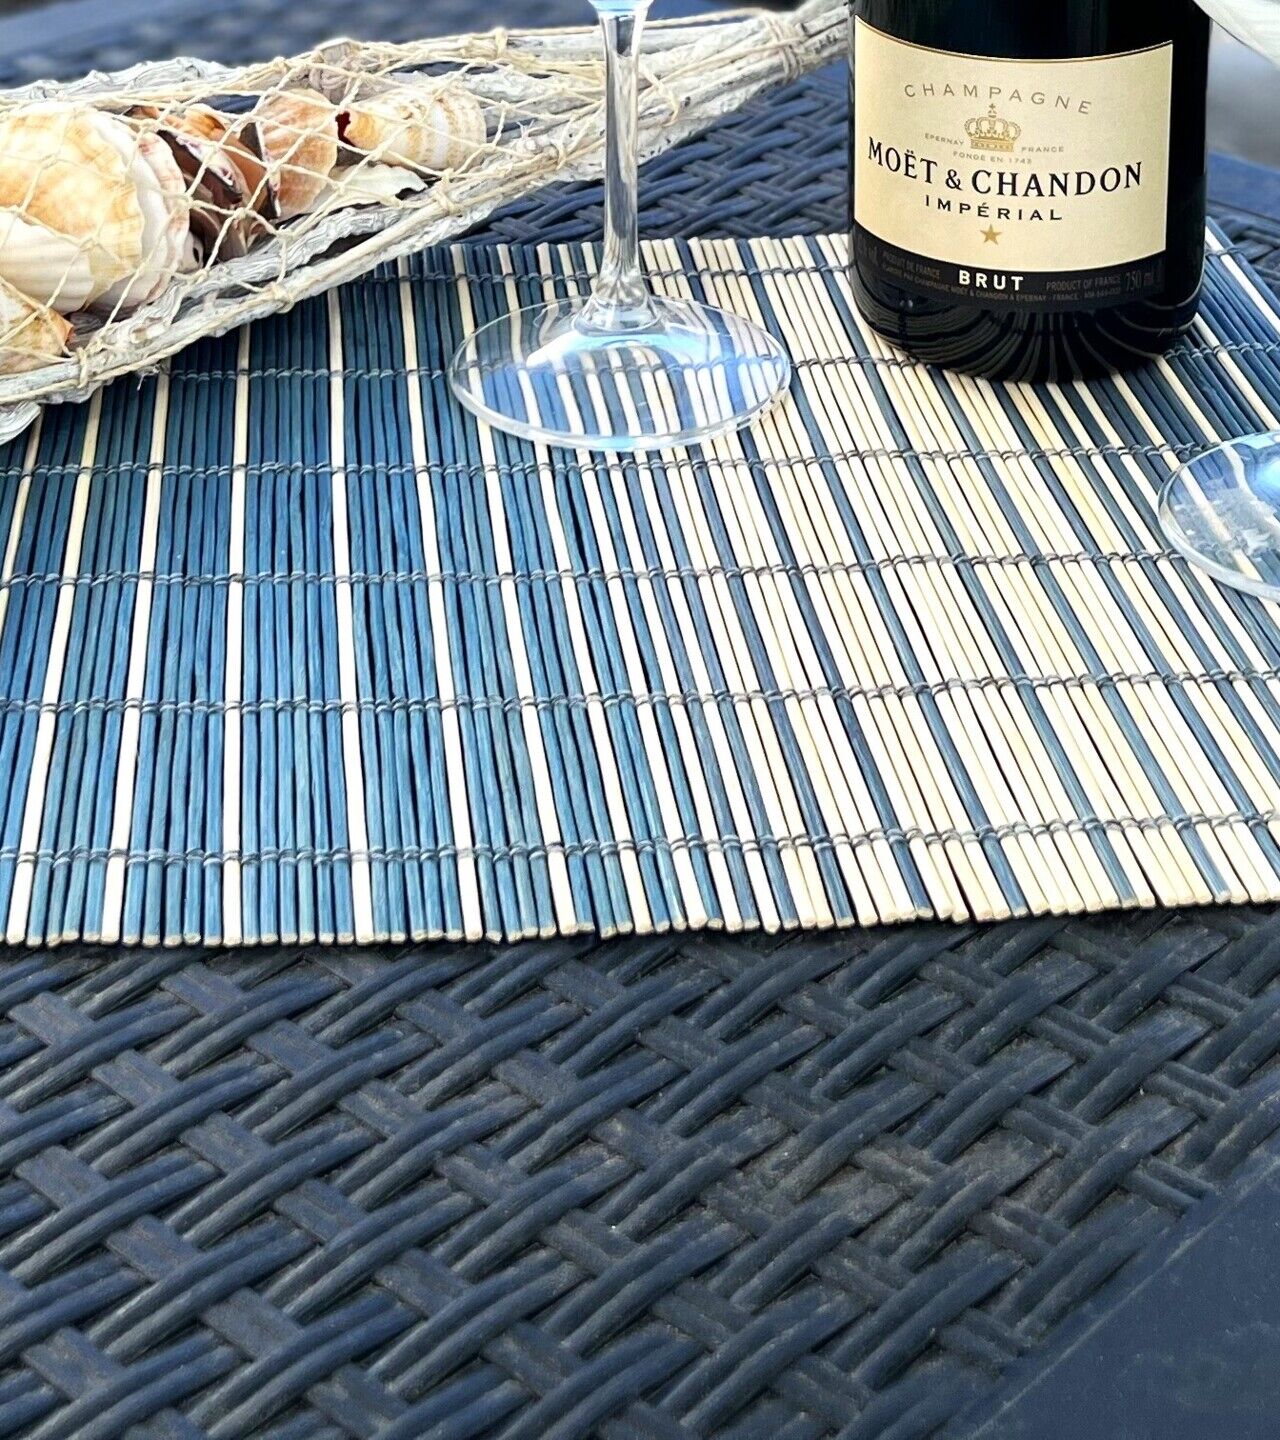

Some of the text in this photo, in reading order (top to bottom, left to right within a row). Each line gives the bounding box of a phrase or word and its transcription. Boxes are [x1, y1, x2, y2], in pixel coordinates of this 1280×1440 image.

[904, 83, 1092, 115] CHAMPAGNE
[1021, 145, 1065, 153] FRANCE
[868, 136, 1142, 197] MOËT & CHANDON
[925, 194, 1063, 221] IMPÉRIAL
[958, 270, 1024, 291] BRUT
[1046, 280, 1081, 292] PRODUCT
[1083, 278, 1093, 289] OF
